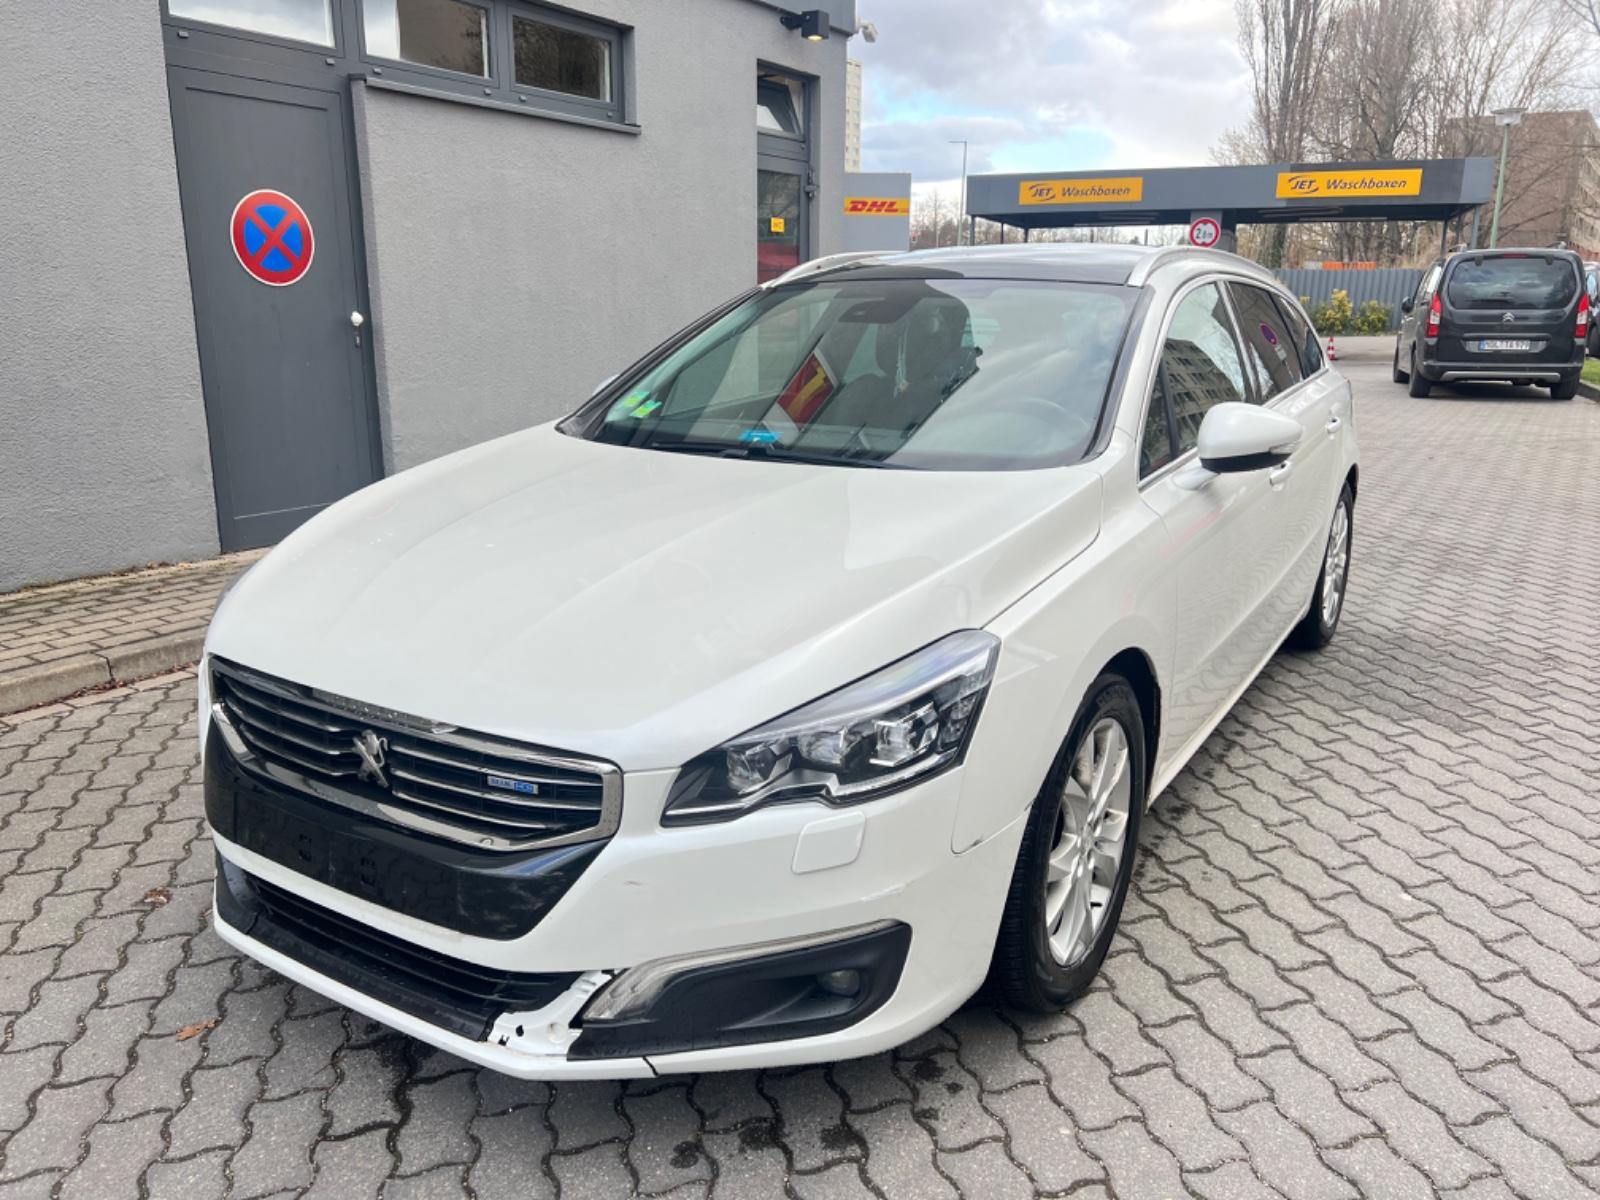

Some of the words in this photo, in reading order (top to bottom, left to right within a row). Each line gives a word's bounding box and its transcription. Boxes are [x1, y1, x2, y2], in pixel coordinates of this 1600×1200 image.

[1290, 178, 1317, 192] JET
[1326, 177, 1407, 190] Waschboxen
[1030, 185, 1054, 199] JET
[1061, 185, 1131, 198] Waschboxen
[847, 200, 899, 213] DHL
